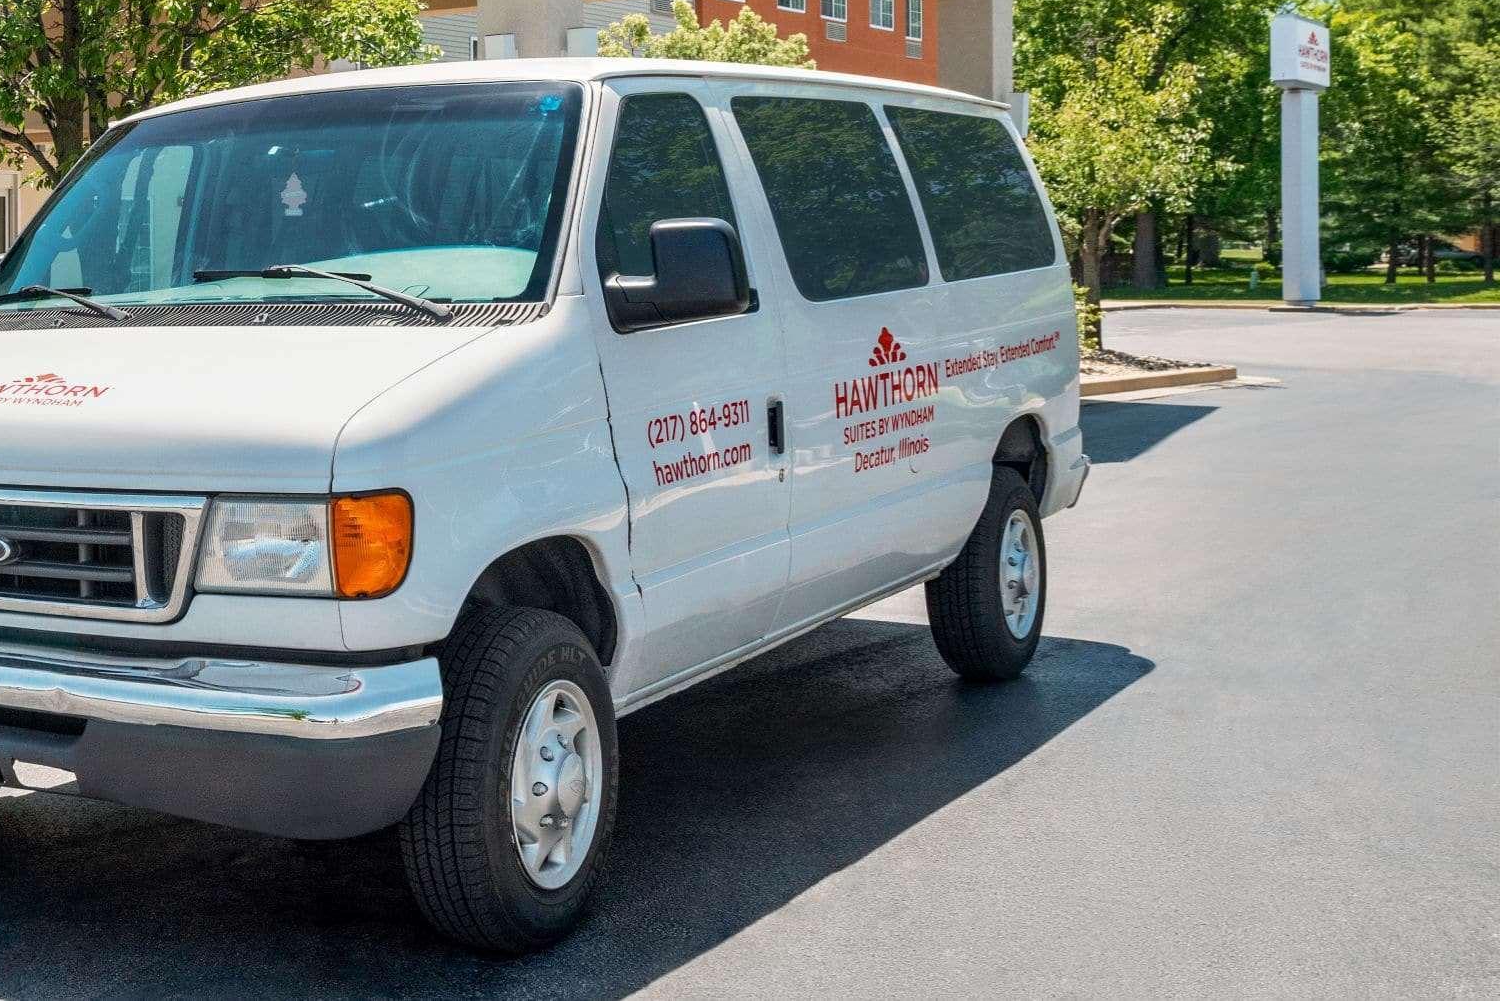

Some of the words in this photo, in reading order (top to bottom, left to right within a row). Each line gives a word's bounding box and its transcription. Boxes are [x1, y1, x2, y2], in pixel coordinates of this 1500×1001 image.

[945, 353, 981, 378] Extended
[1000, 341, 1030, 363] Extended
[835, 362, 939, 419] HAWTHORN
[647, 414, 685, 449] (217)
[689, 400, 750, 436] 864-9311
[843, 420, 877, 445] SUITES
[879, 416, 891, 435] BY
[891, 405, 935, 432] WYNDHAM
[652, 443, 752, 486] hawthorn.com
[898, 434, 930, 460] Illinois
